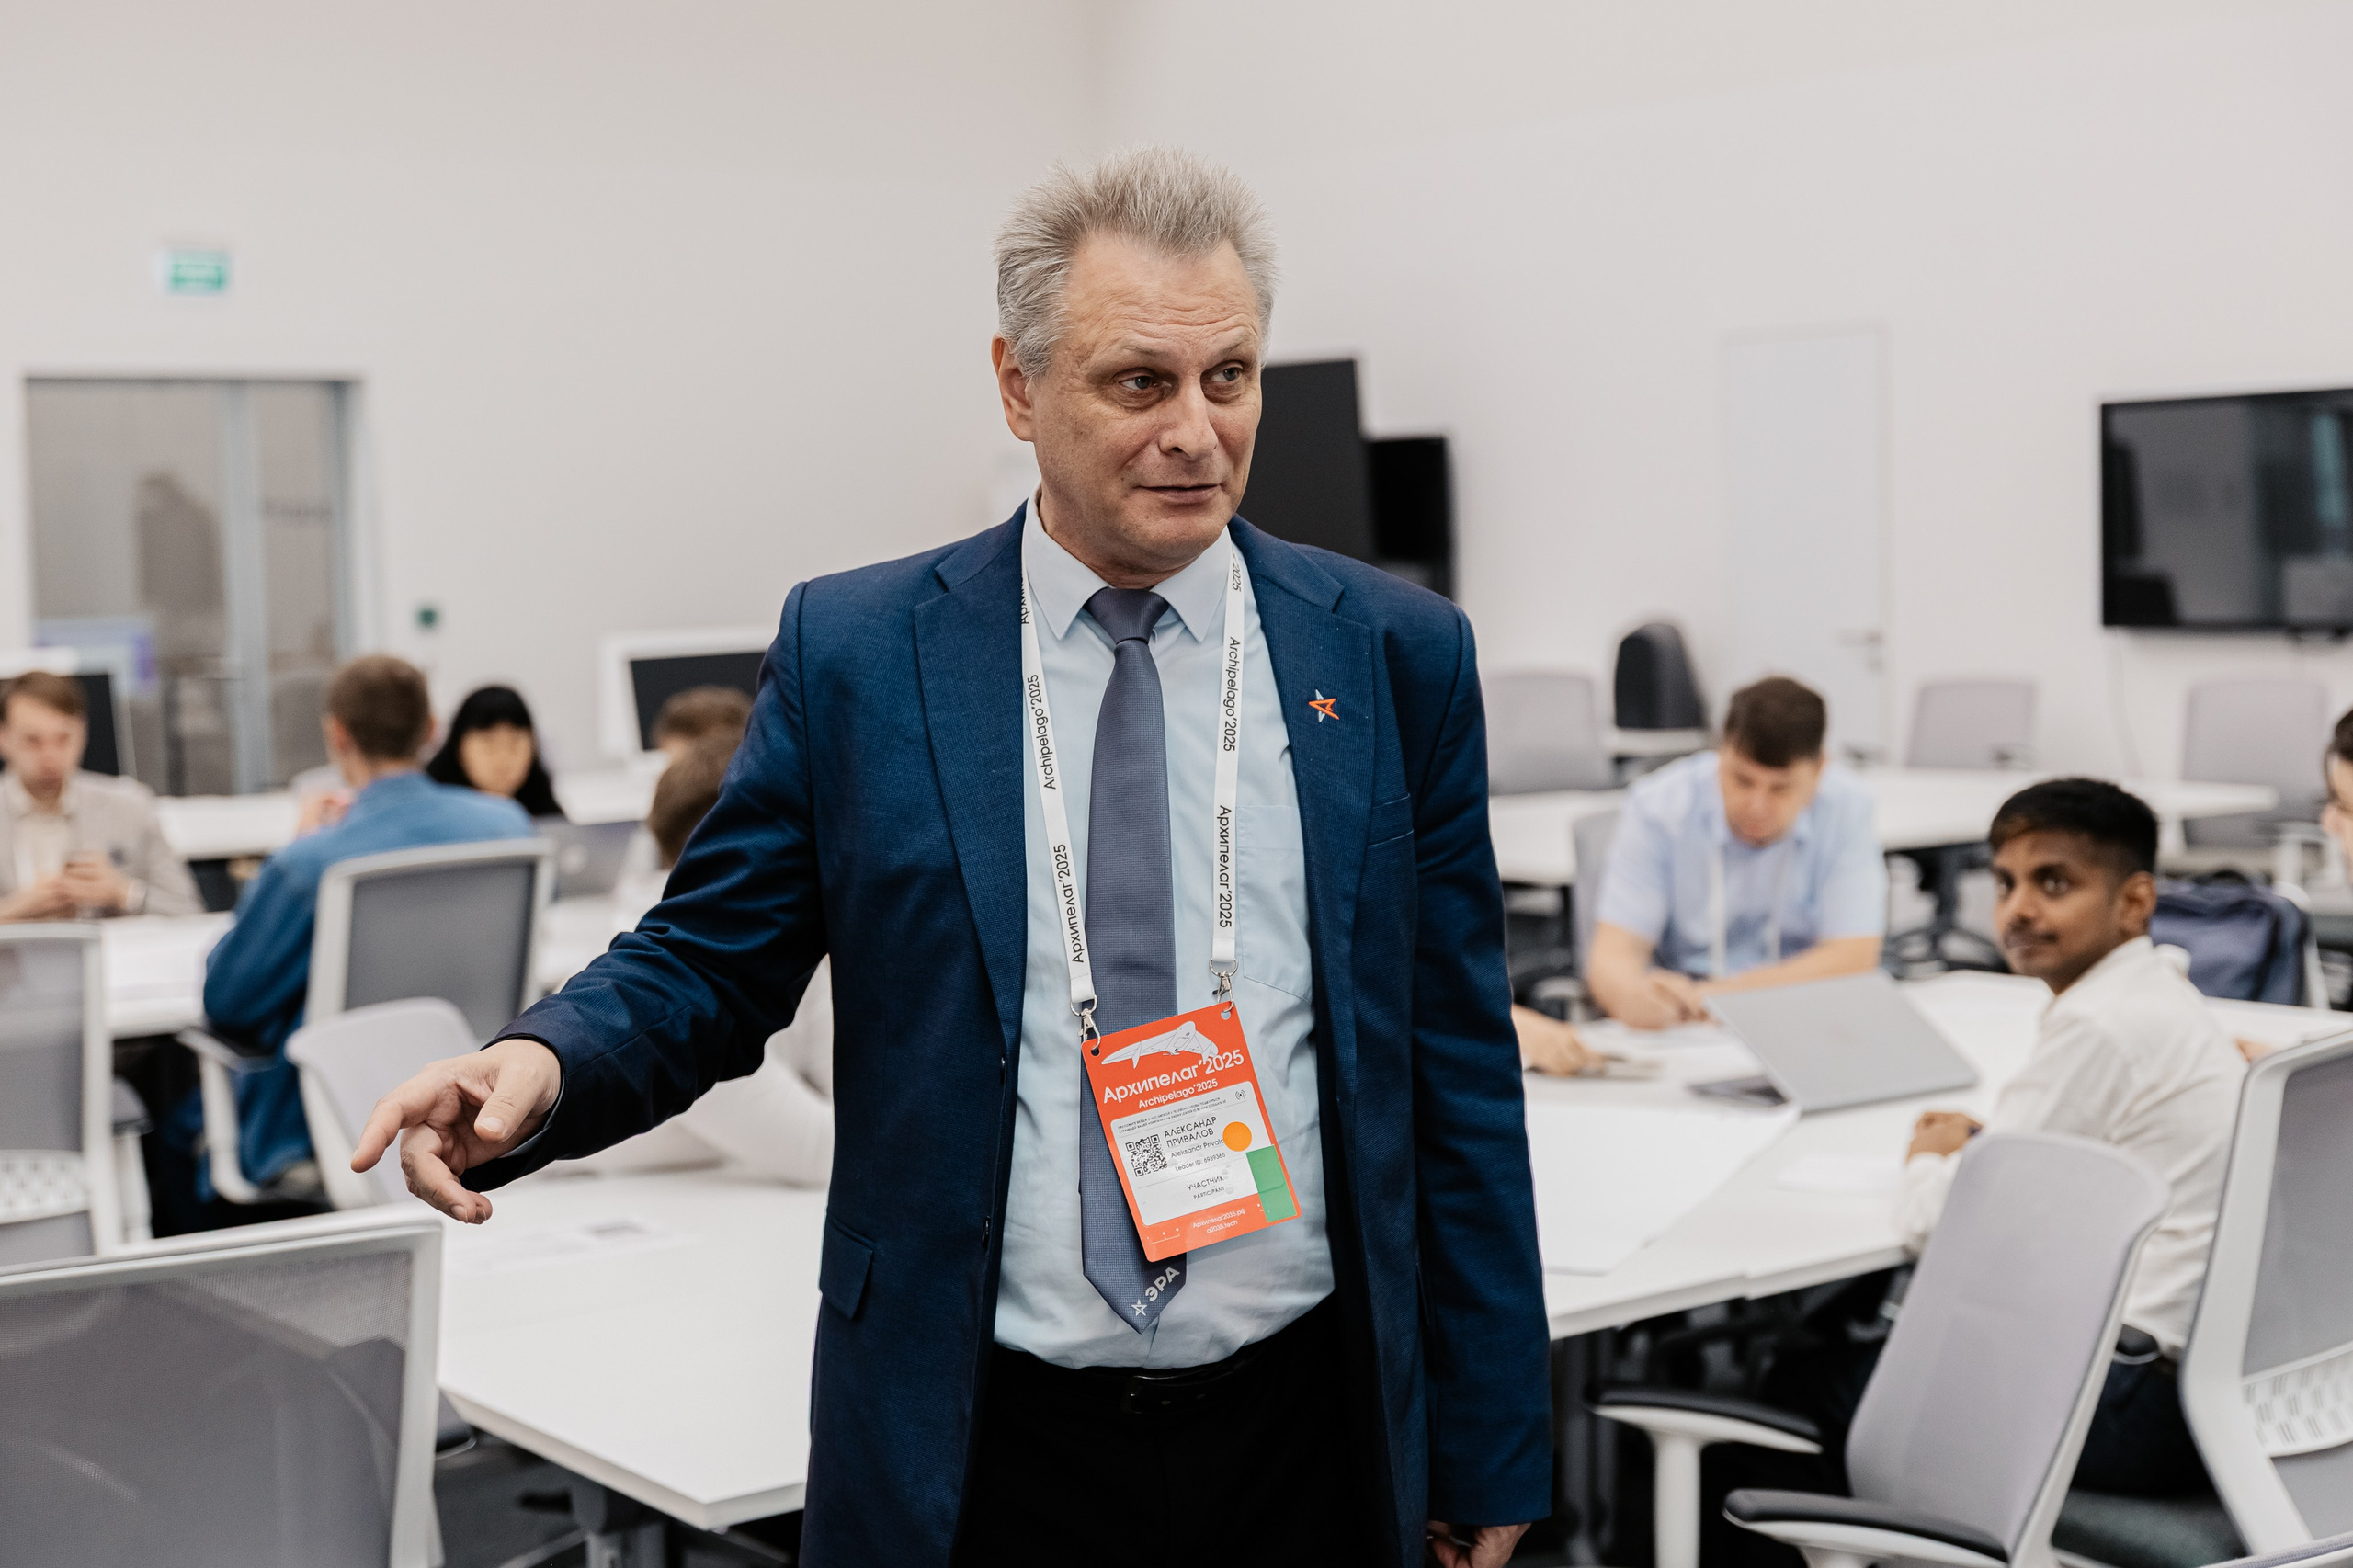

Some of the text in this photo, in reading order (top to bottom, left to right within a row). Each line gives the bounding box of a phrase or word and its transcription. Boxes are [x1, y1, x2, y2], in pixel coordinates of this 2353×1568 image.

[1223, 636, 1242, 752] Archipelago'2025
[1027, 674, 1056, 790] Archipelago'2025
[1217, 805, 1233, 928] Архипелаг'2025
[1053, 844, 1084, 963] Архипелаг'2025
[1103, 1049, 1245, 1104] Архипелаг'2025
[1139, 1078, 1218, 1109] Archipelago'2025
[1164, 1116, 1217, 1138] АЛЕКСАНДР
[1166, 1128, 1214, 1148] ПРИВАЛОВ
[1171, 1138, 1224, 1158] Aleksandr Privalo
[1175, 1161, 1195, 1172] Leader
[1187, 1175, 1225, 1191] УЧАСТНИК
[1193, 1186, 1225, 1199] PARTICIPANT
[1144, 1267, 1180, 1301] ЭРА
